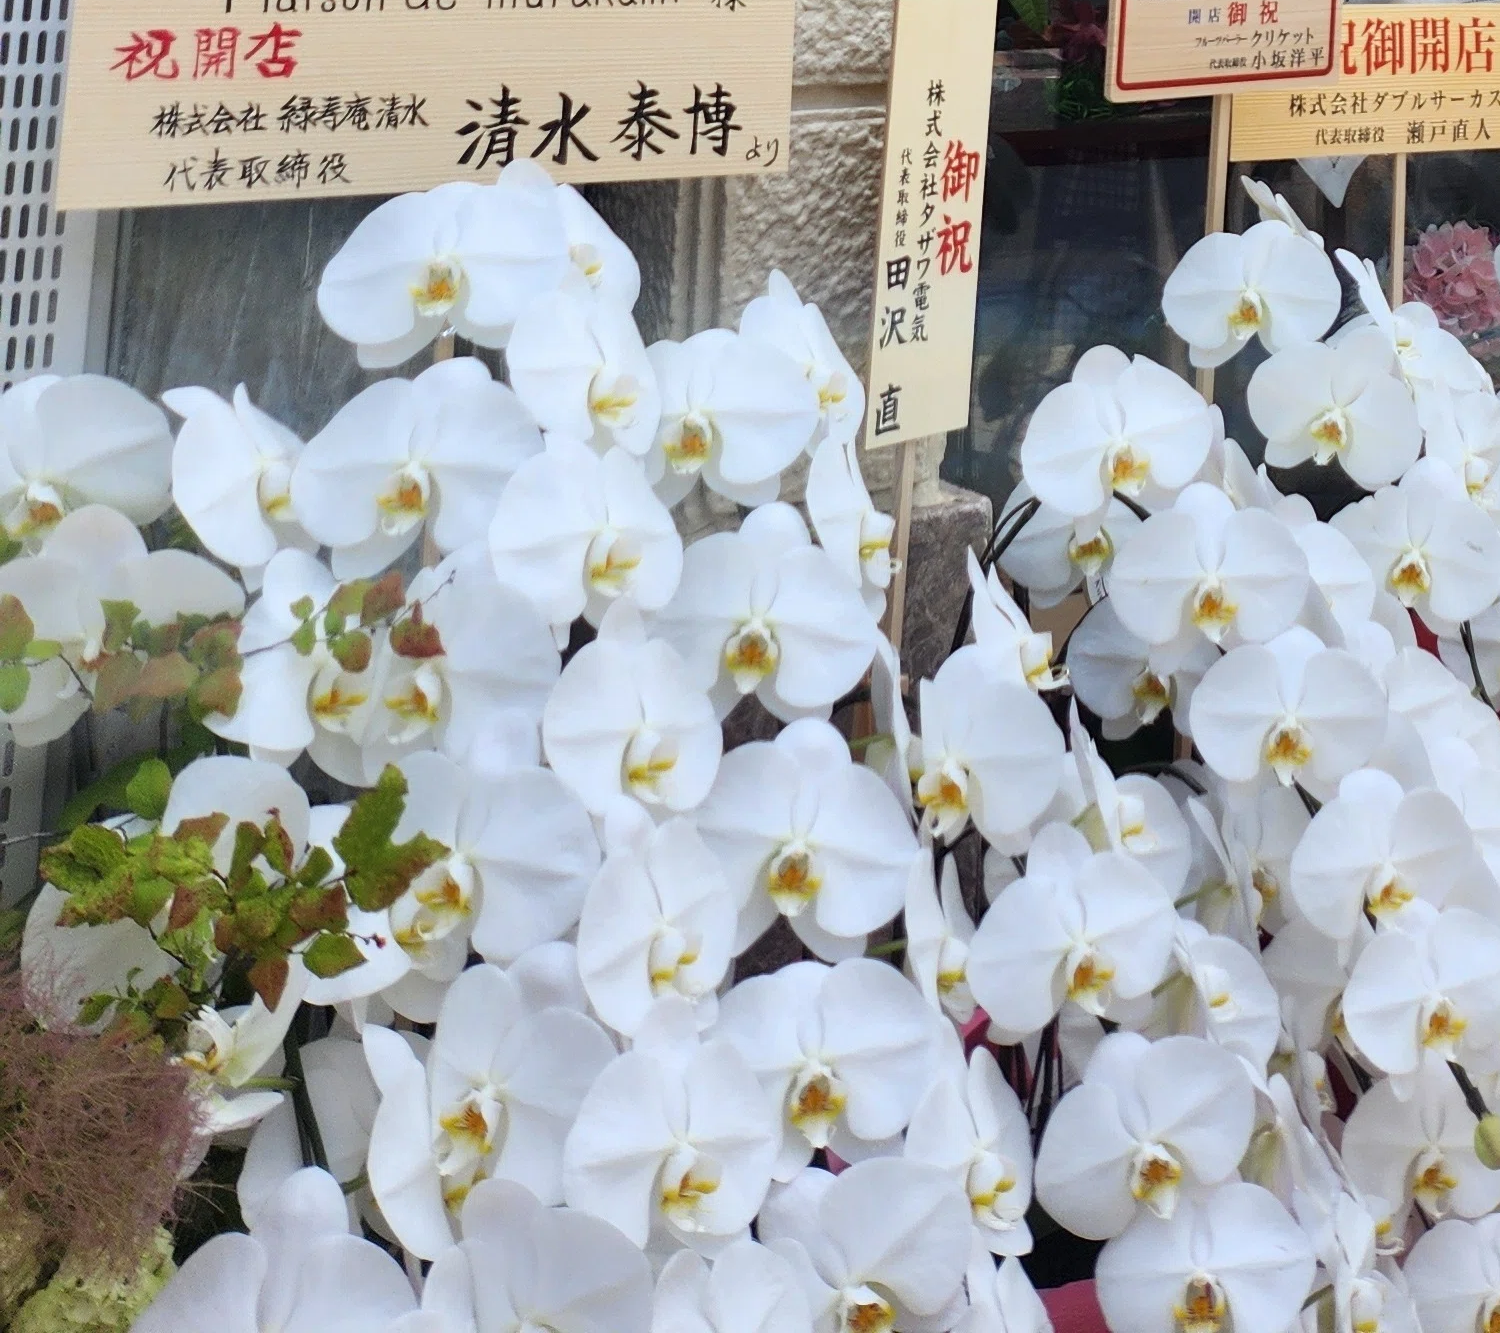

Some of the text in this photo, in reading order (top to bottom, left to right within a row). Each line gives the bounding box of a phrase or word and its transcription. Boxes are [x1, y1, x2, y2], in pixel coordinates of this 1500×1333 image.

[110, 23, 303, 81] 祝開店
[1251, 27, 1315, 48] クリケット
[1251, 47, 1325, 71] 小坂洋平
[1315, 117, 1491, 145] 代表取締役 瀬戸直人
[163, 146, 353, 192] 代表取締役
[894, 147, 914, 248] 代表取締役
[909, 79, 946, 342] 株式会社タザワ電気
[935, 139, 980, 276] 御祝
